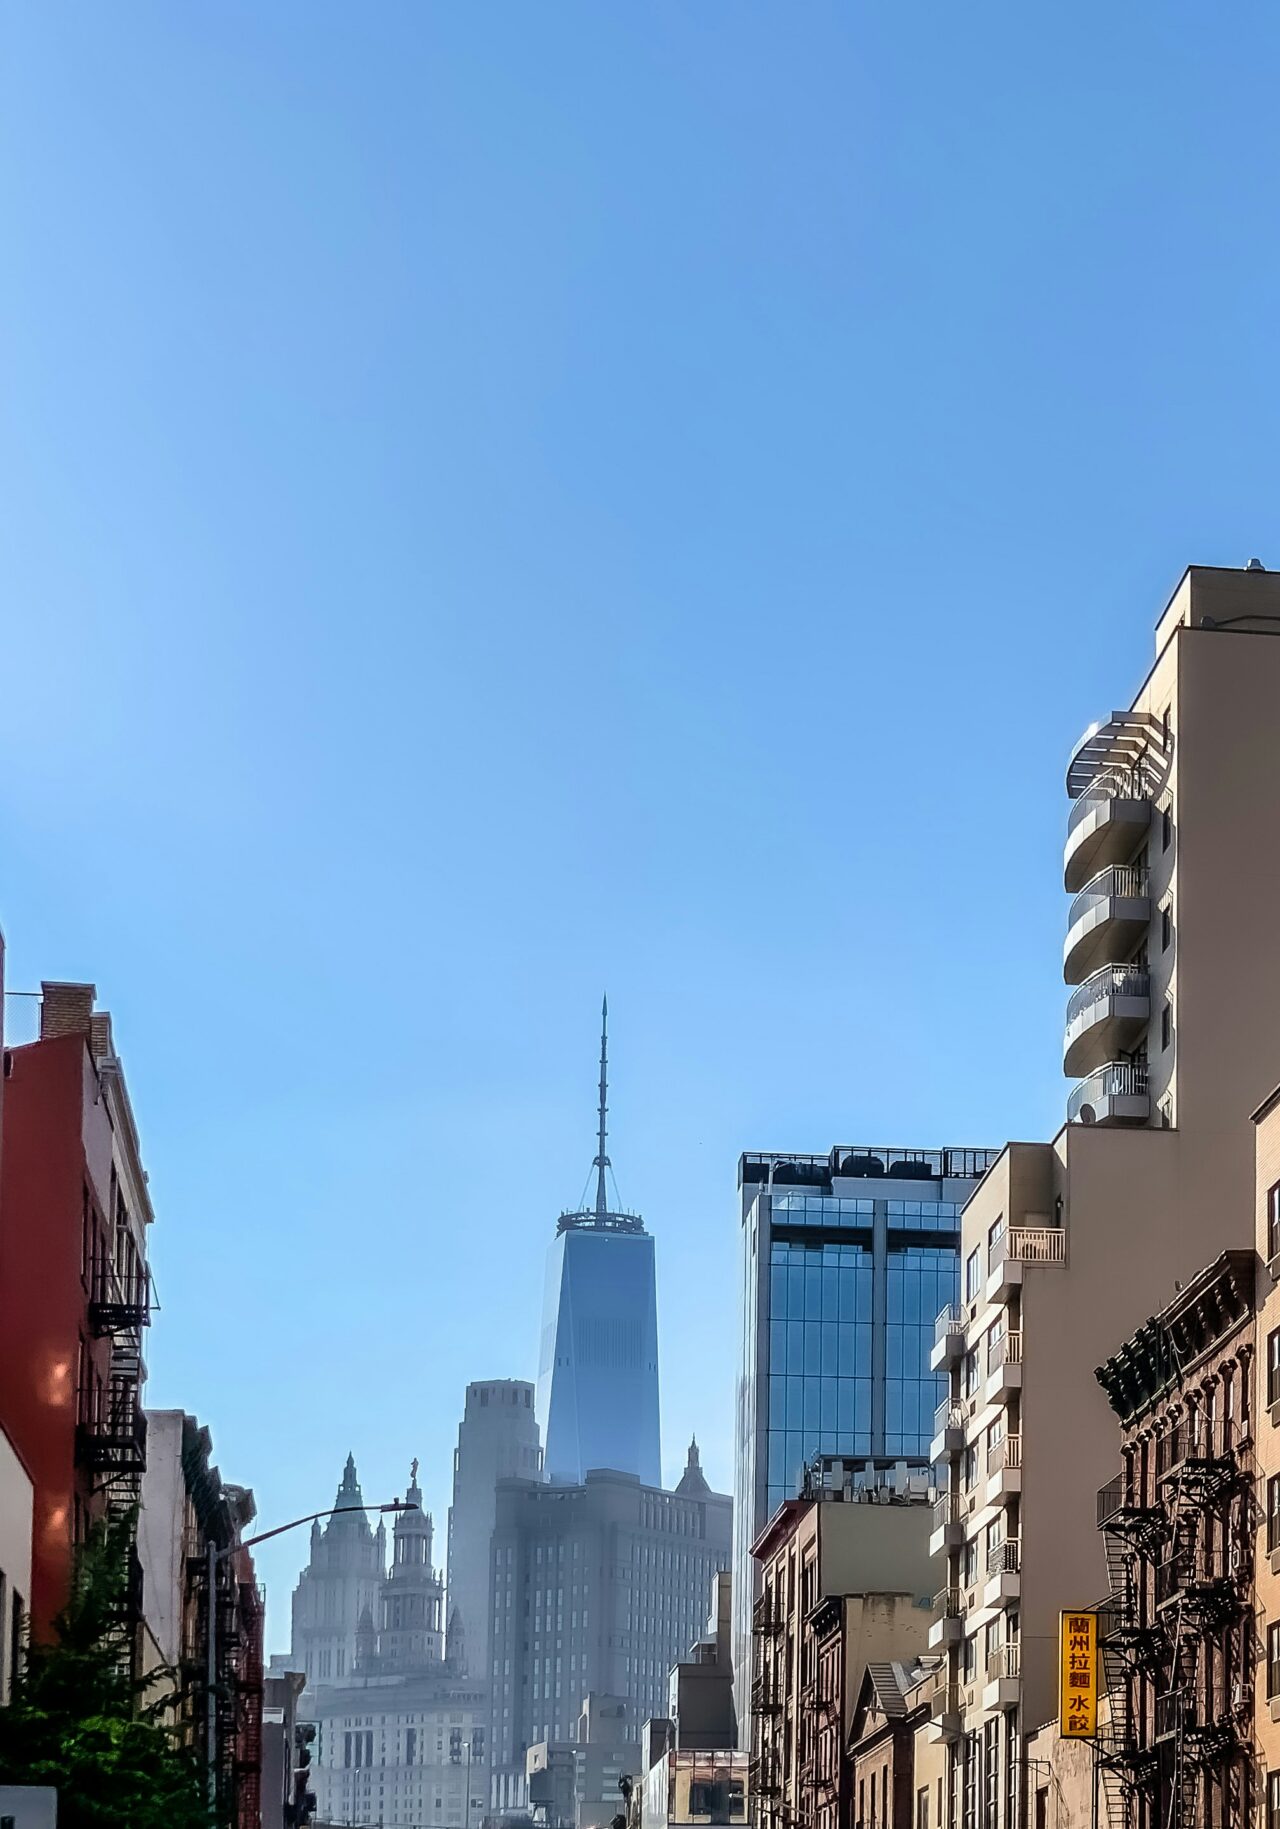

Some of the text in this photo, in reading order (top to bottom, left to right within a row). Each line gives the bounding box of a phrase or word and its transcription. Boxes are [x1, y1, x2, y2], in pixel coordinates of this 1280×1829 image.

[1068, 1617, 1091, 1731] 蘭州拉麵 水餃
